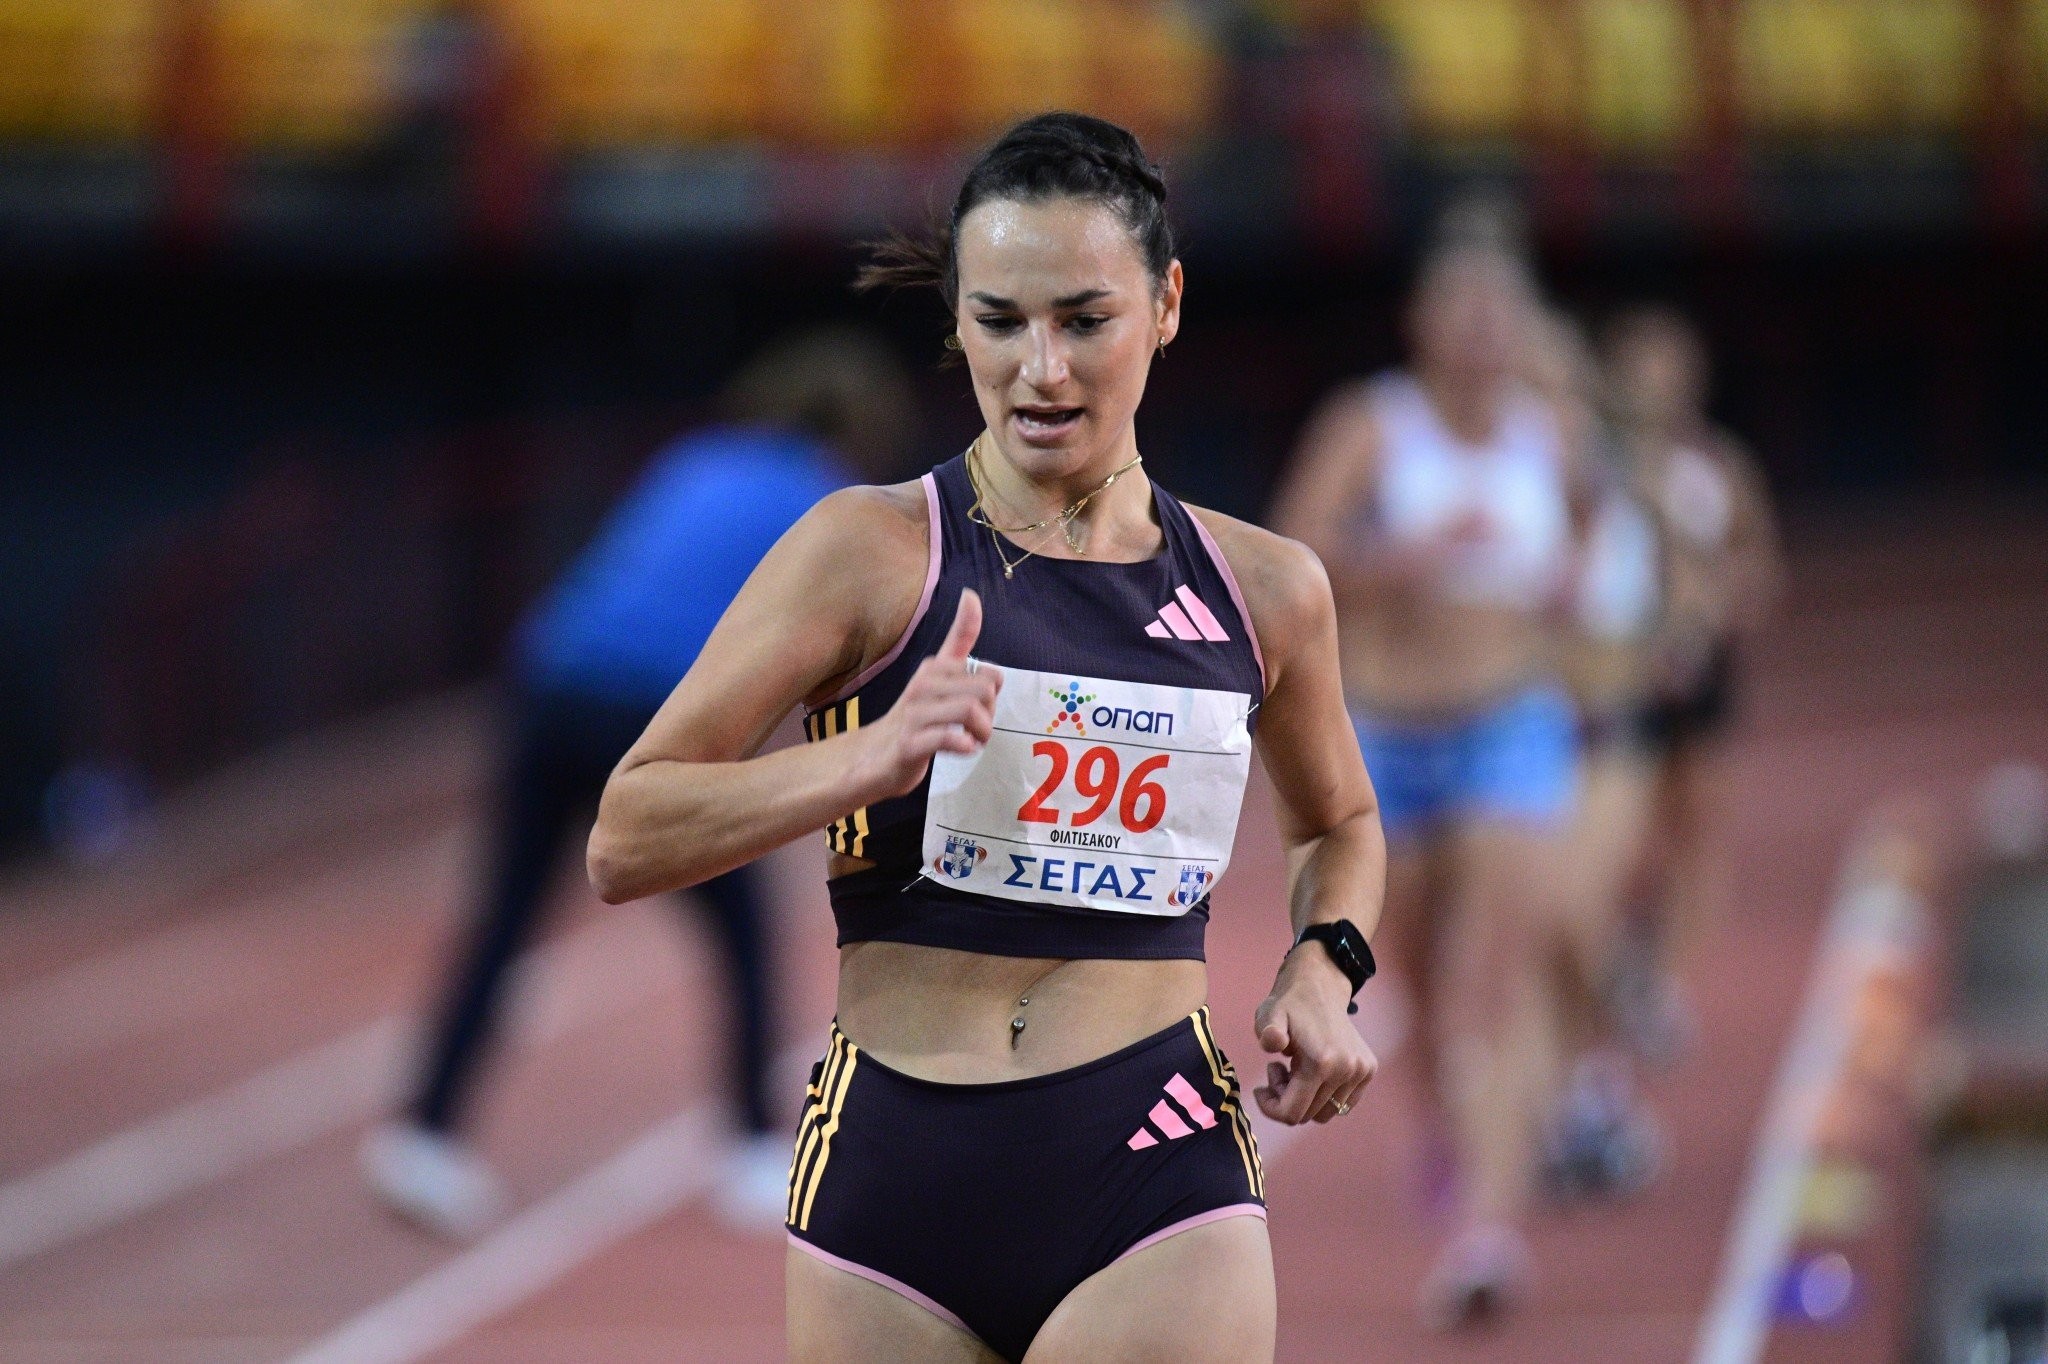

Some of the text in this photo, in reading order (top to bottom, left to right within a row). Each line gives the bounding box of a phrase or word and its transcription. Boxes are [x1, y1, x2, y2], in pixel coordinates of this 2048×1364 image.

[1017, 740, 1171, 834] 296
[946, 834, 977, 847] ΣΕΓΑΣ
[1050, 829, 1121, 849] ΦΙΛΤΙΣΑΚΟΥ
[1003, 853, 1156, 901] ΣΕΓΑΣ
[1181, 864, 1206, 873] ΣΕΓΑΣ
